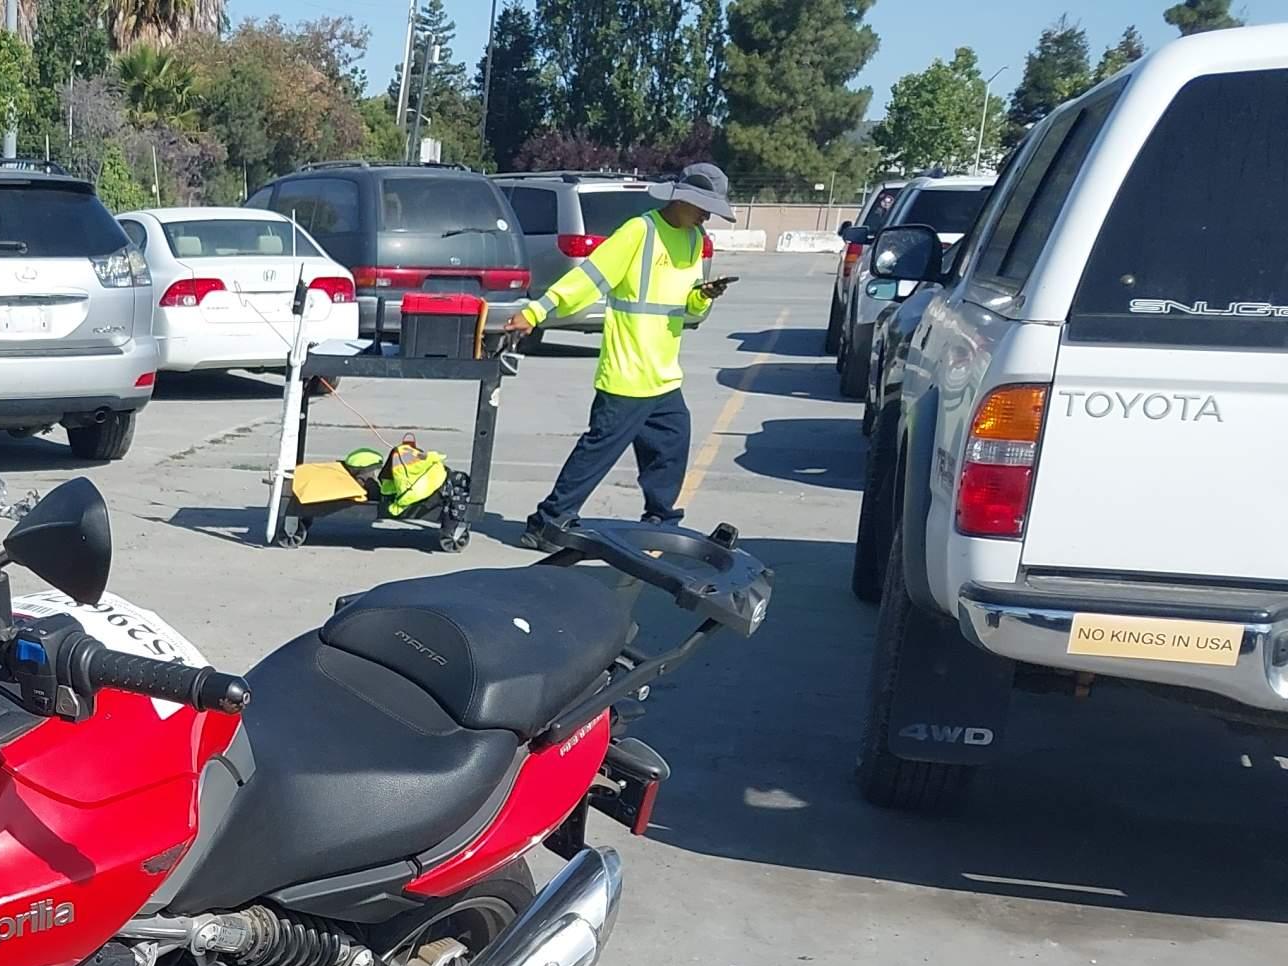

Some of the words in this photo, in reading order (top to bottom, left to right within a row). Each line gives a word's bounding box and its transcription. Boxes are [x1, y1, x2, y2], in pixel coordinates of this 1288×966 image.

[1058, 390, 1224, 423] TOYOTA
[1077, 627, 1105, 641] NO
[1110, 630, 1166, 646] KINGS
[1171, 634, 1191, 648] IN
[1196, 636, 1233, 651] USA
[898, 723, 994, 745] 4WD
